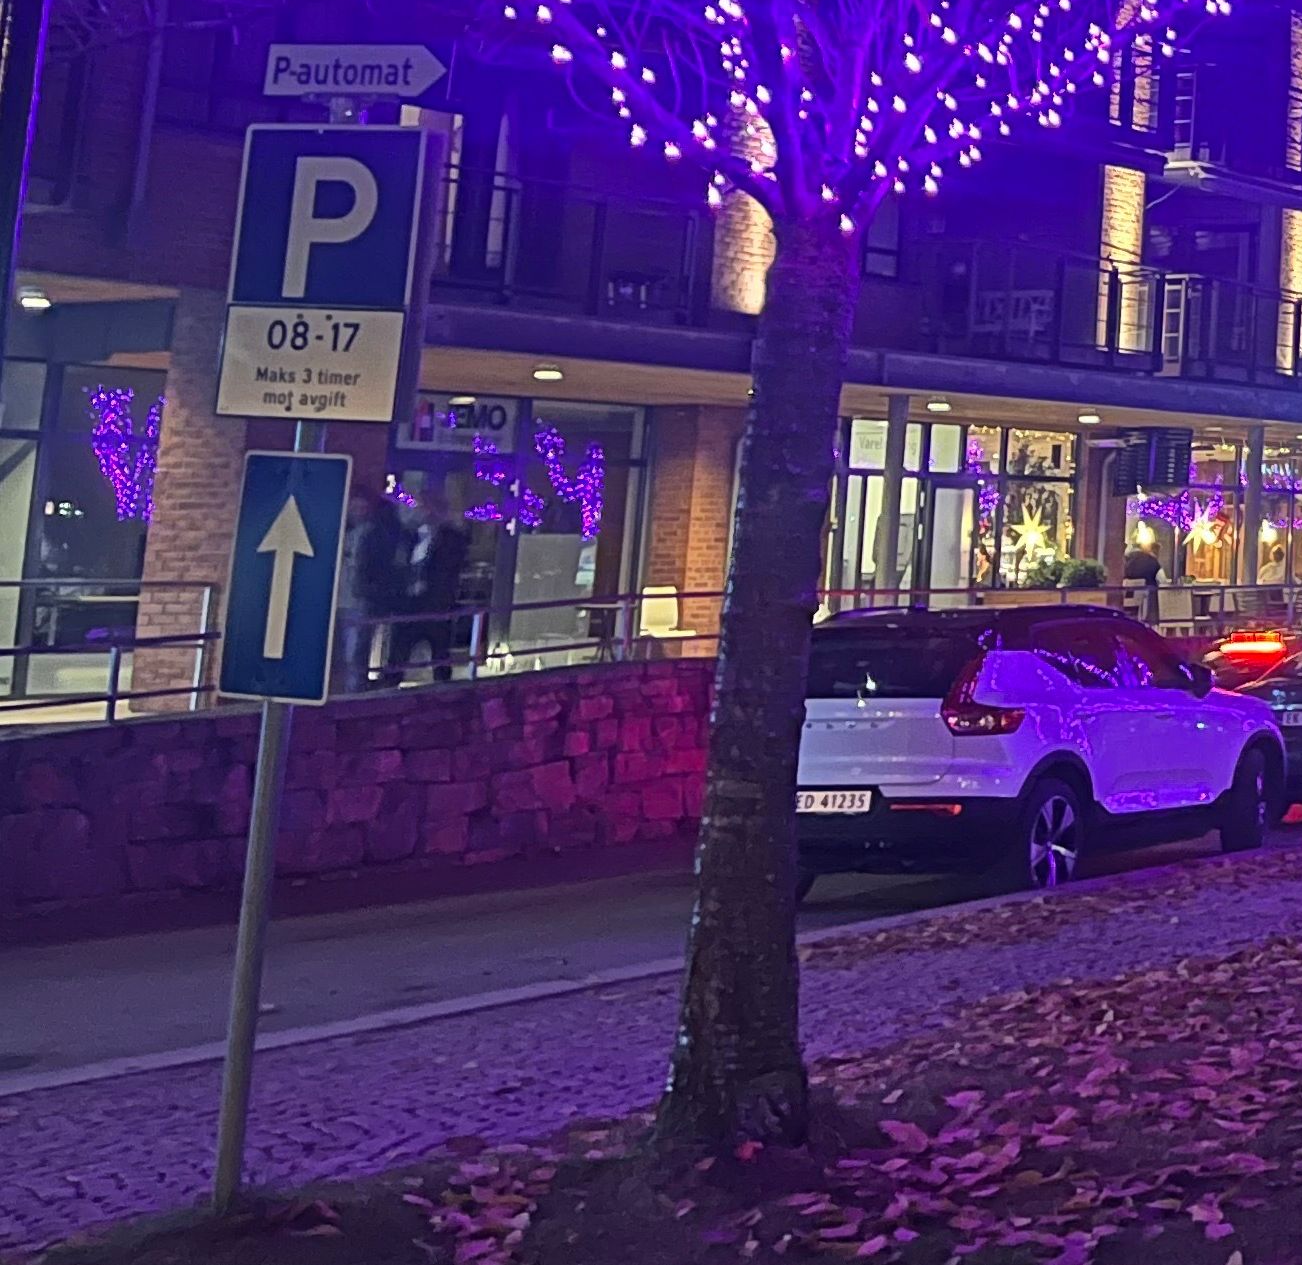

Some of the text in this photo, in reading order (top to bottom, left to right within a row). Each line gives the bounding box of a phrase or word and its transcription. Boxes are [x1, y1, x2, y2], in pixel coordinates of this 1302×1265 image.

[272, 55, 414, 85] P-automat
[281, 156, 378, 298] P
[255, 367, 361, 387] Maks 3 timer
[263, 391, 347, 413] mot avgift
[819, 794, 867, 809] 41235
